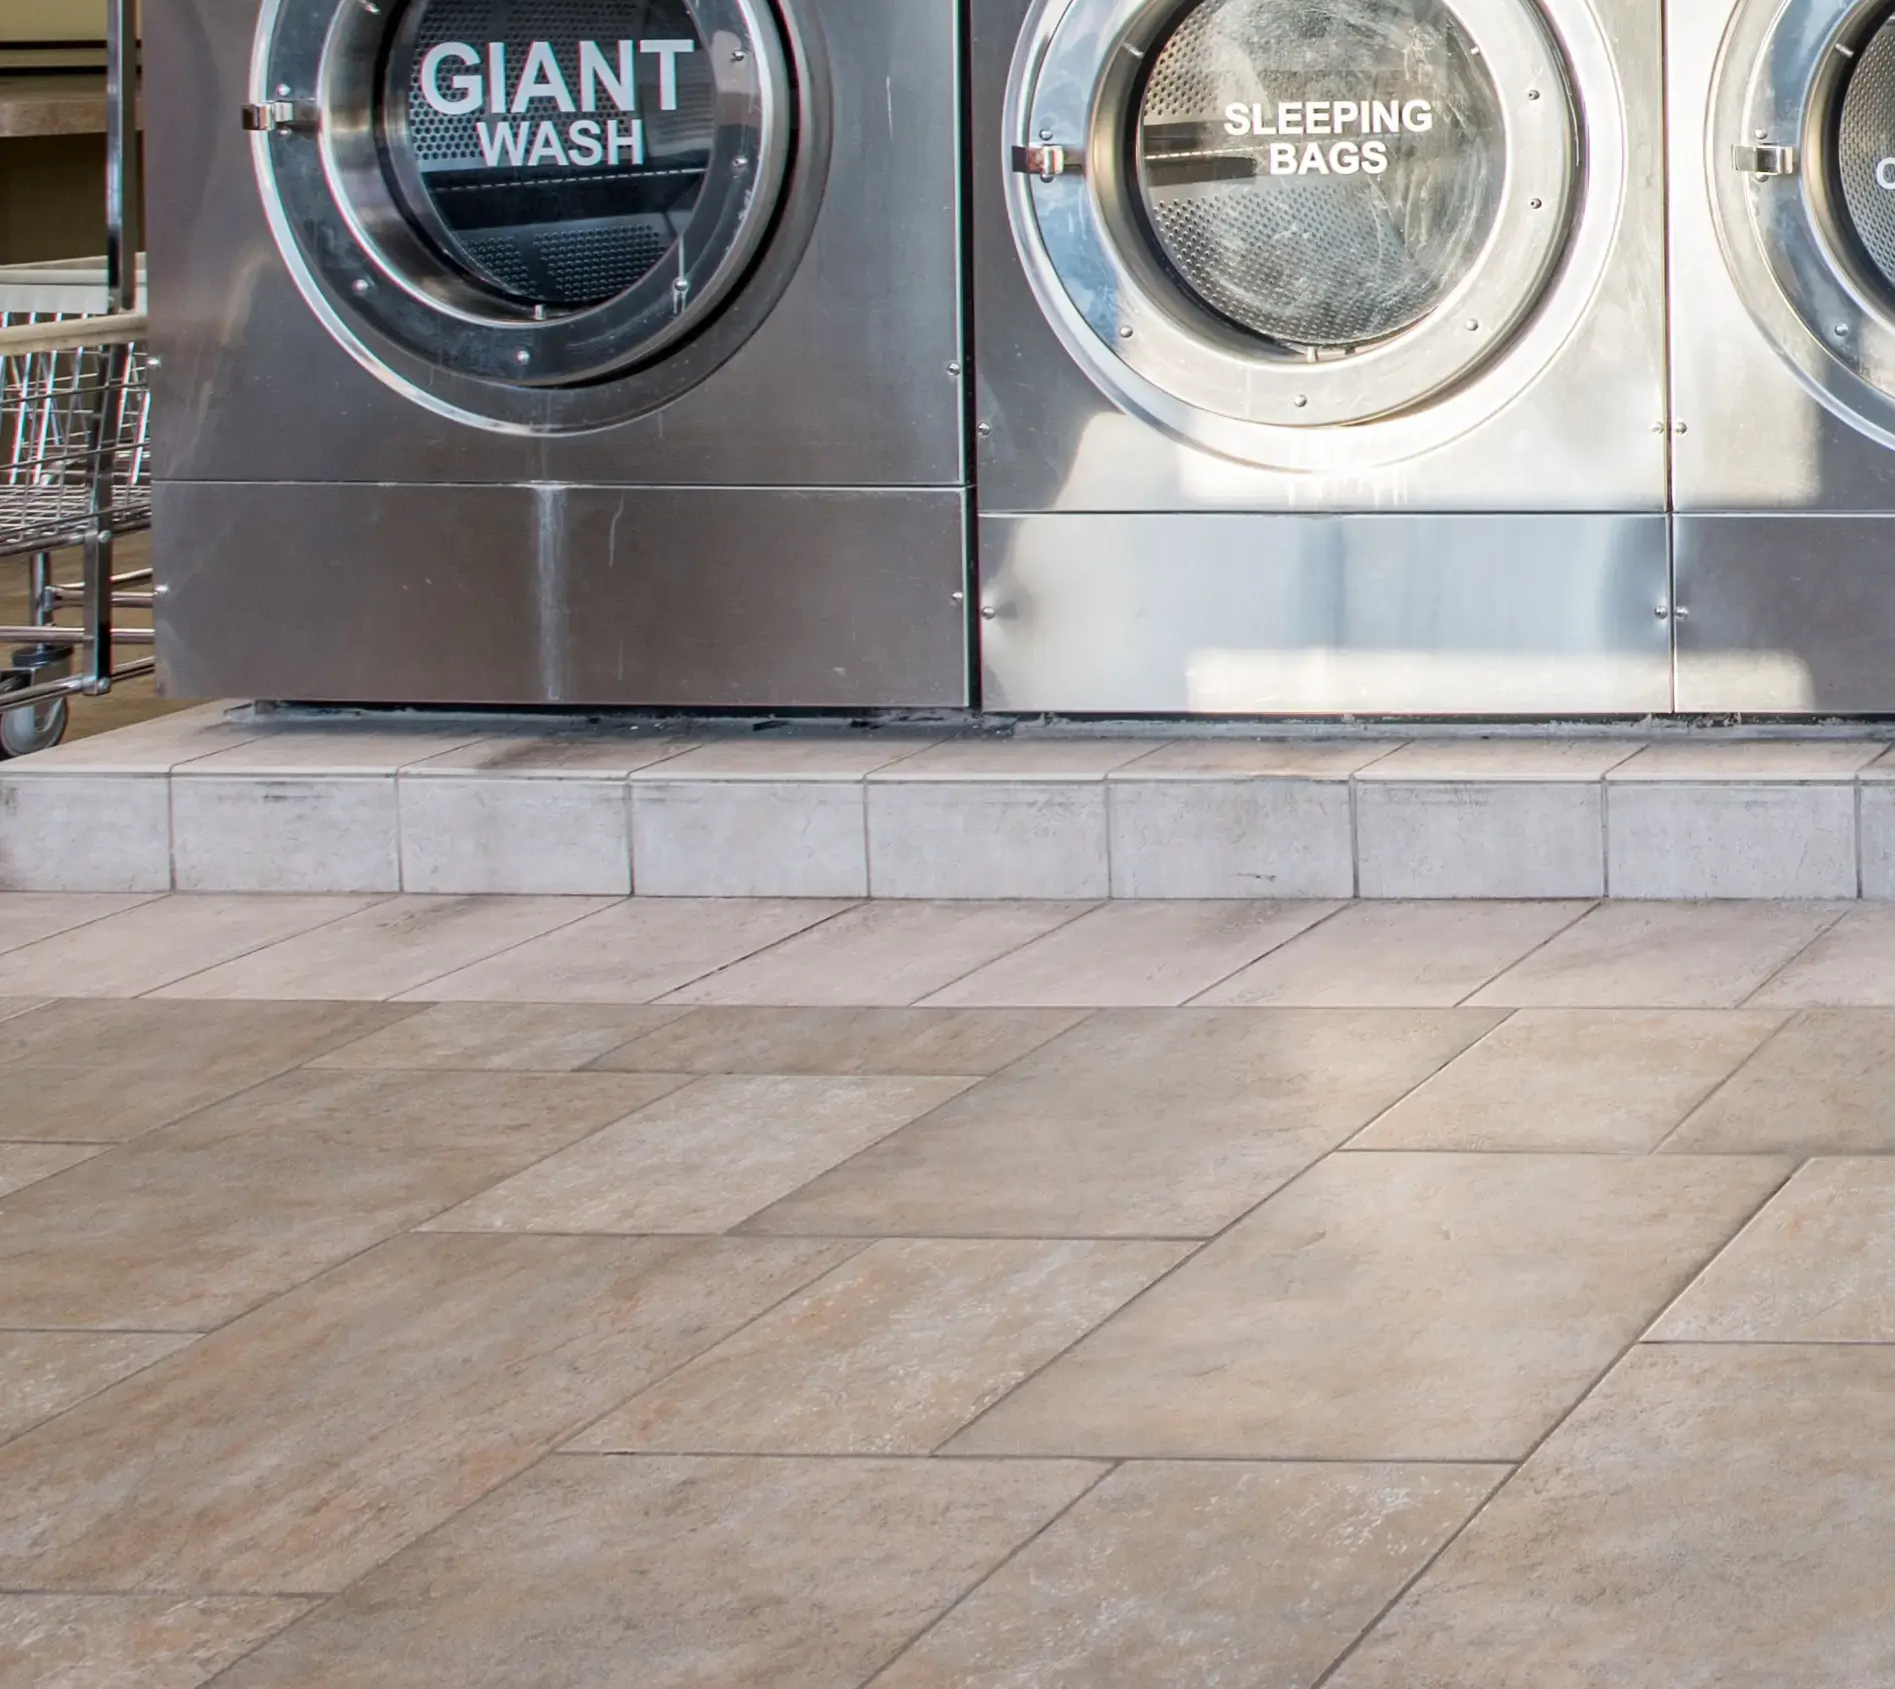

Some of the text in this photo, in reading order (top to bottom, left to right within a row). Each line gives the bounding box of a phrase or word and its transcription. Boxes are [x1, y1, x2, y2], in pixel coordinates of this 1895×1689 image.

[420, 39, 694, 114] GIANT
[1224, 99, 1433, 135] SLEEPING
[476, 119, 644, 166] WASH
[1269, 141, 1388, 175] BAGS
